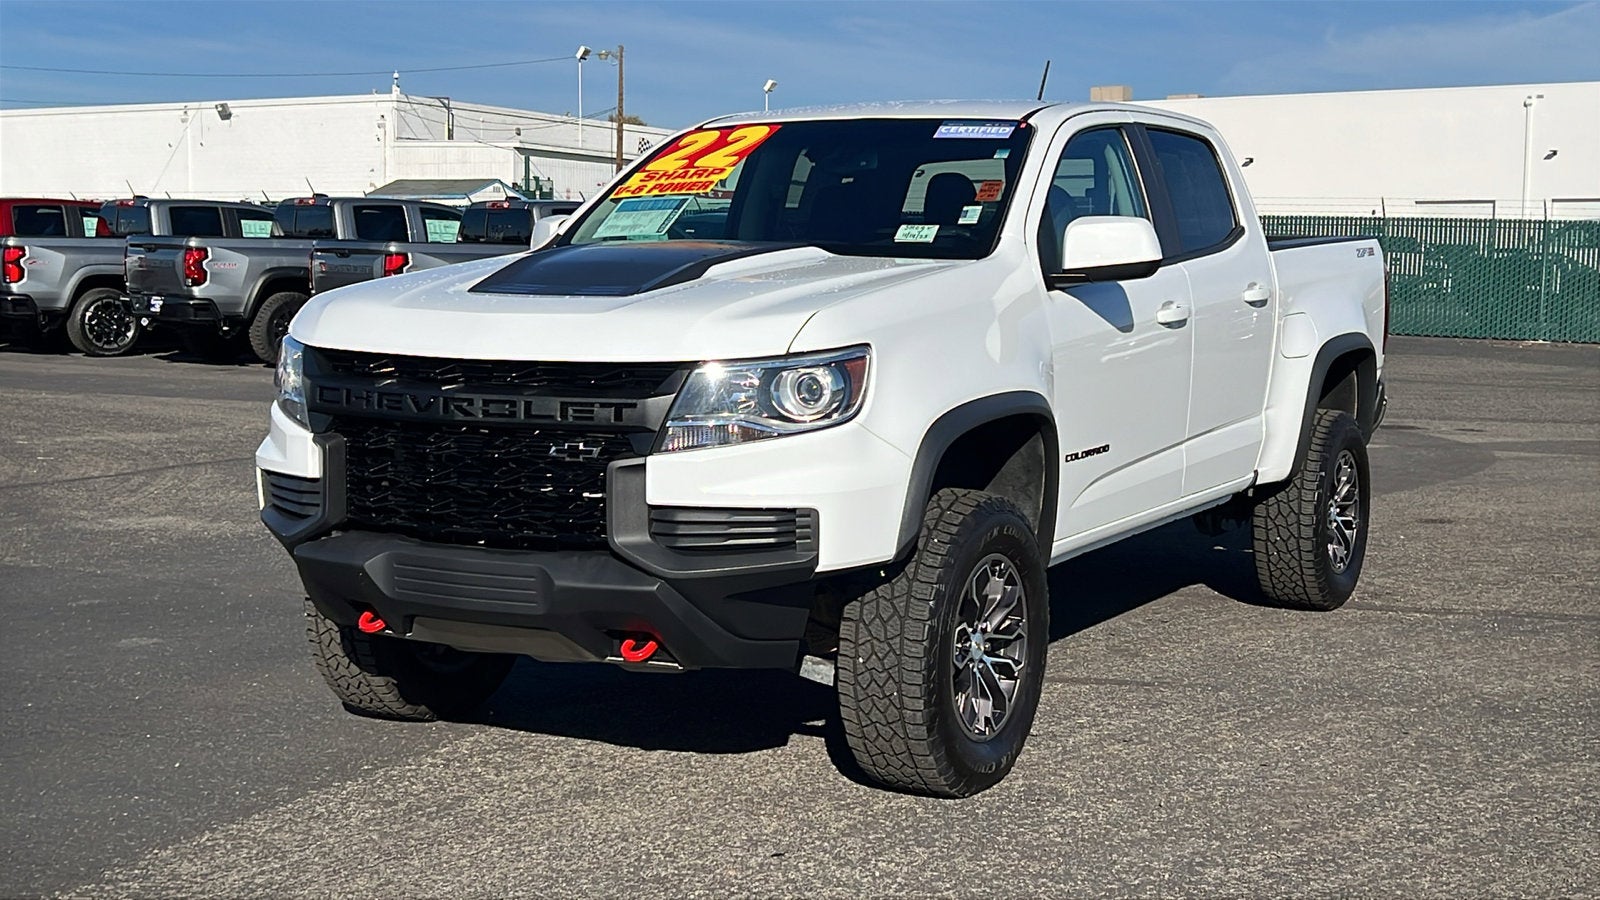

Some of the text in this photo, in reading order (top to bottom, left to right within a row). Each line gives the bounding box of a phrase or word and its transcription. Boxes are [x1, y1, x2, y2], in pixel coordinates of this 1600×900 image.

[940, 126, 1010, 134] CERTIFIED
[644, 125, 770, 171] 22
[640, 166, 728, 183] SHARP
[613, 180, 716, 197] V-6 POWER
[314, 385, 639, 424] CHEVROLET
[1064, 443, 1110, 463] COLORADO
